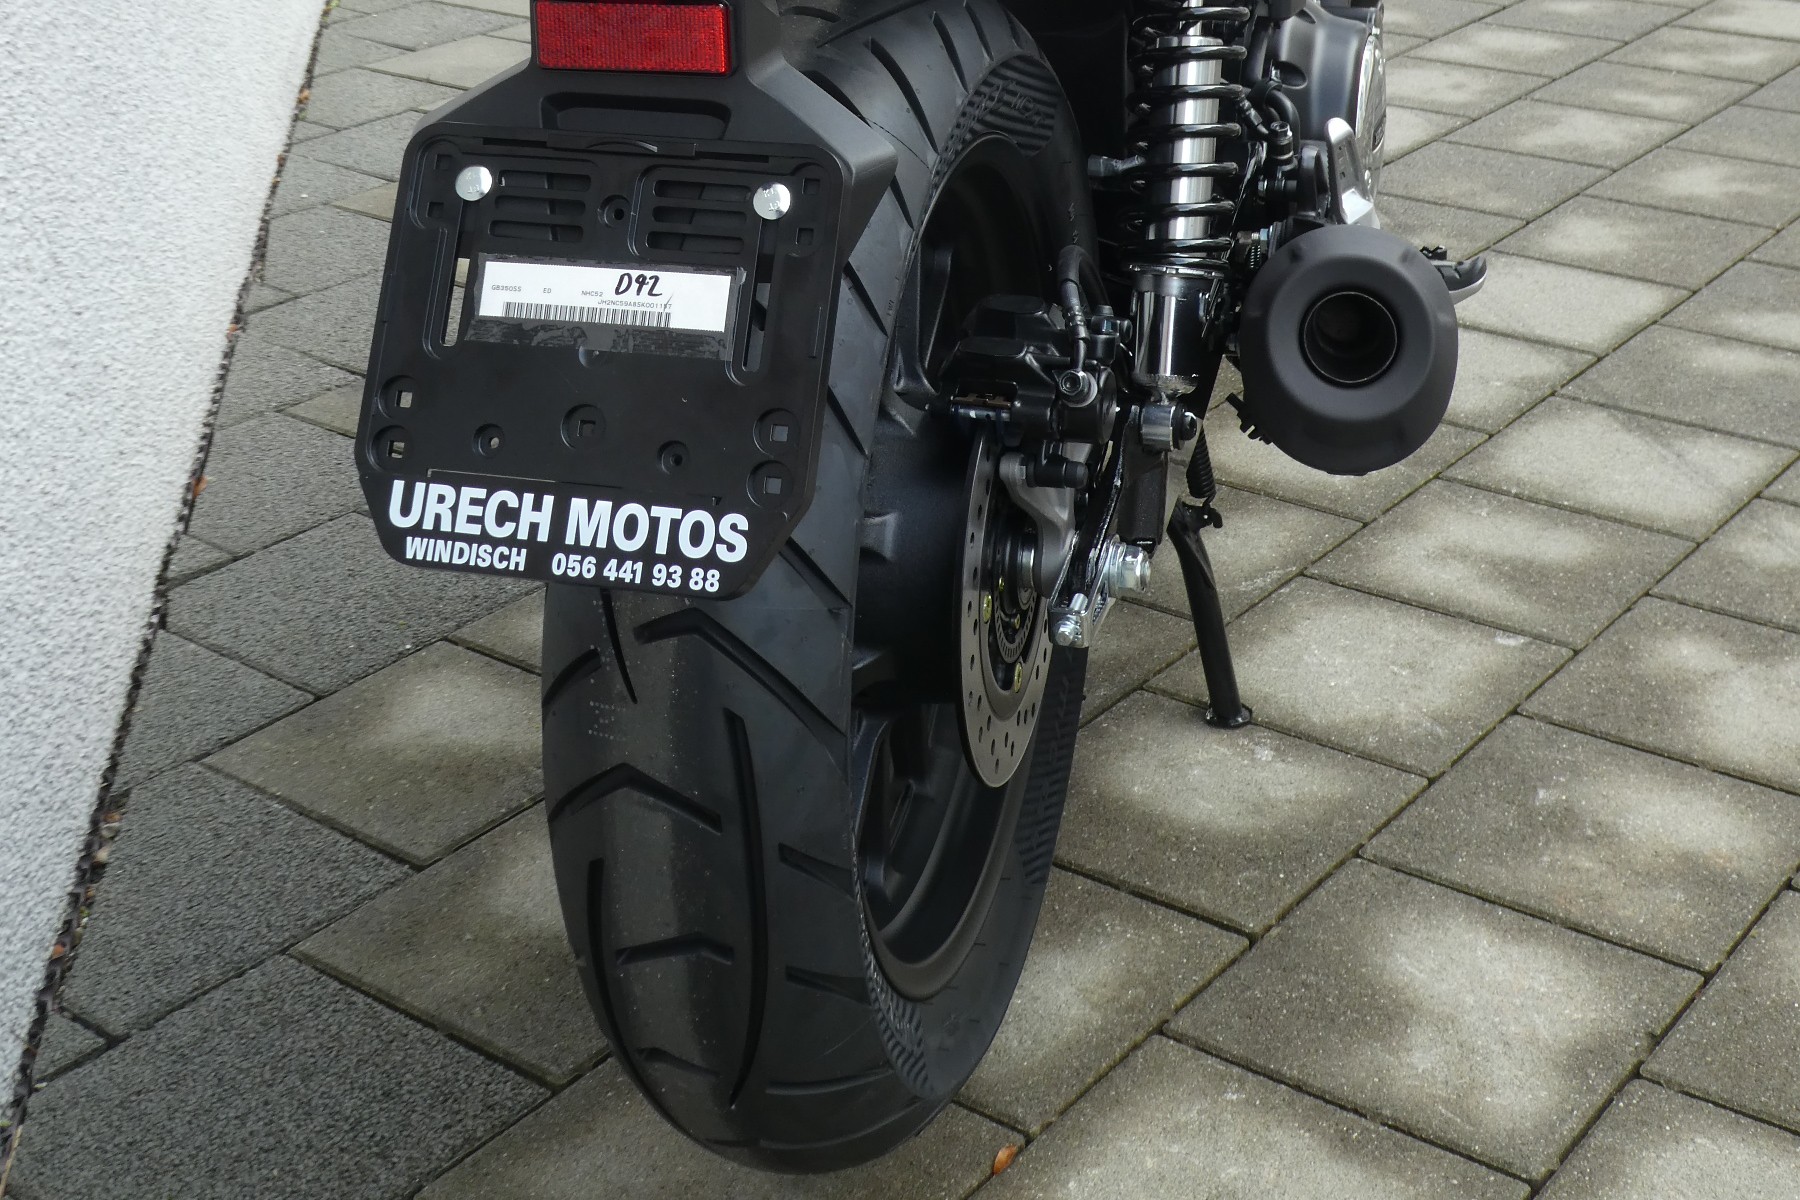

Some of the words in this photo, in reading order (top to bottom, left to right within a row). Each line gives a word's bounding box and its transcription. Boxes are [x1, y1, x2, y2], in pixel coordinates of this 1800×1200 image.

[389, 479, 555, 543] URECH
[564, 497, 750, 563] MOTOS
[405, 536, 528, 572] WINDISCH
[551, 552, 597, 579] 056
[602, 558, 644, 585] 441
[651, 563, 682, 589] 93
[688, 567, 721, 593] 88
